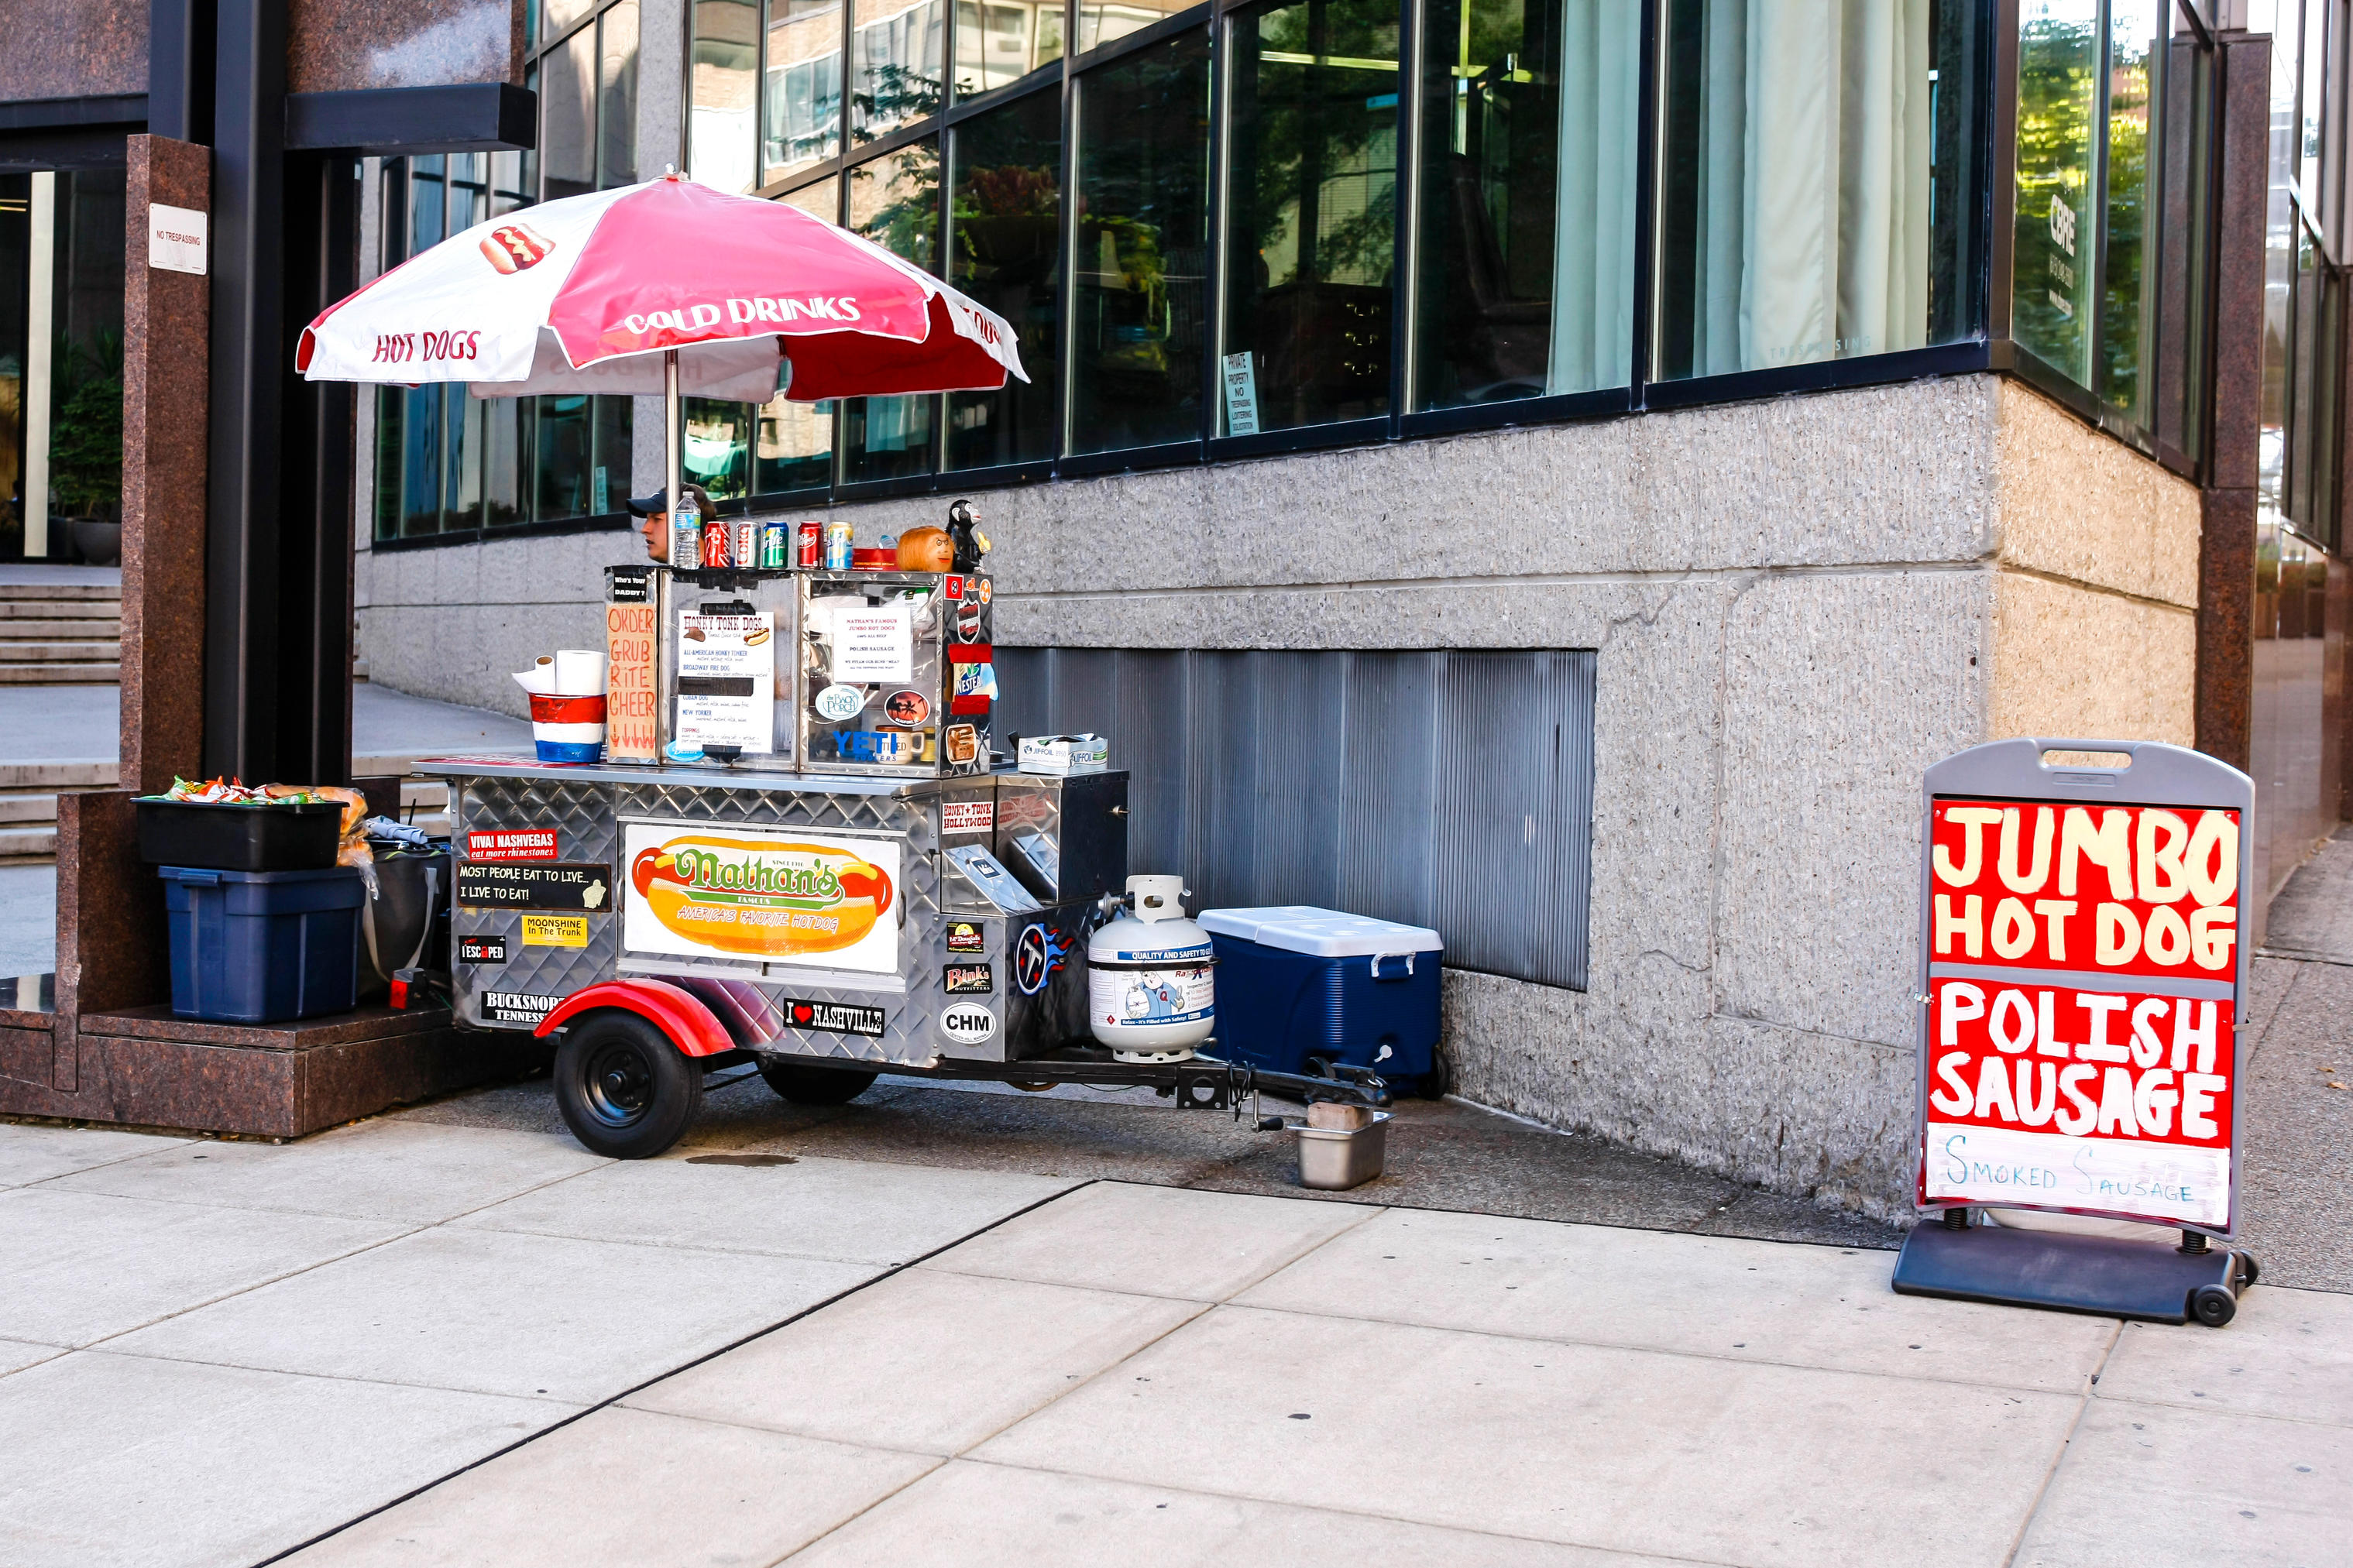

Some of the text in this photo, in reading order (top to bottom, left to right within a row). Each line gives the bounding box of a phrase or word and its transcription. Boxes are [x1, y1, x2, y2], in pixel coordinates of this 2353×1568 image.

[2050, 194, 2076, 257] CBRE
[156, 230, 200, 246] NO TRESPASSING
[623, 296, 861, 335] COLD DRINKS
[371, 330, 482, 363] HOT DOGS
[1228, 353, 1246, 370] PRIVATE
[1228, 372, 1248, 386] PROPERTY
[1235, 387, 1244, 397] NO
[608, 608, 654, 634] ORDER
[684, 616, 762, 631] HONKY TONK DOGS
[611, 639, 650, 662] GRUB
[957, 675, 982, 695] NESTEA
[609, 691, 655, 717] CHEER
[827, 700, 856, 713] PORCH
[834, 694, 855, 703] BACK
[832, 731, 897, 755] YETI
[944, 803, 992, 816] HONKY TONK
[944, 817, 992, 829] HOLLYWOOD
[471, 834, 553, 849] VIVA! NASHVEGAS
[507, 847, 553, 857] rhinestones
[1933, 807, 2238, 907] JUMBO
[460, 866, 487, 877] MOST
[489, 867, 520, 880] PEOPLE
[524, 869, 542, 881] EAT
[544, 870, 558, 881] TO
[675, 849, 838, 897] Nathan's
[460, 887, 529, 901] I LIVE TO EAT!
[738, 896, 771, 905] FAMOUS
[528, 918, 581, 928] MOONSHINE
[678, 907, 736, 922] AMERICA'S
[741, 910, 789, 927] FAVORITE
[1934, 894, 2237, 972] HOT DOG
[1132, 951, 1162, 960] QUALITY
[1163, 951, 1178, 959] AND
[1179, 949, 1200, 959] SAFETY
[946, 966, 990, 991] Bink's
[1160, 991, 1168, 1002] Q
[495, 1009, 548, 1022] TENNESS
[786, 1002, 882, 1033] I NASHVILLE
[946, 1014, 989, 1031] CHM
[1939, 981, 2218, 1074] POLISH
[1929, 1052, 2227, 1139] SAUSAGE
